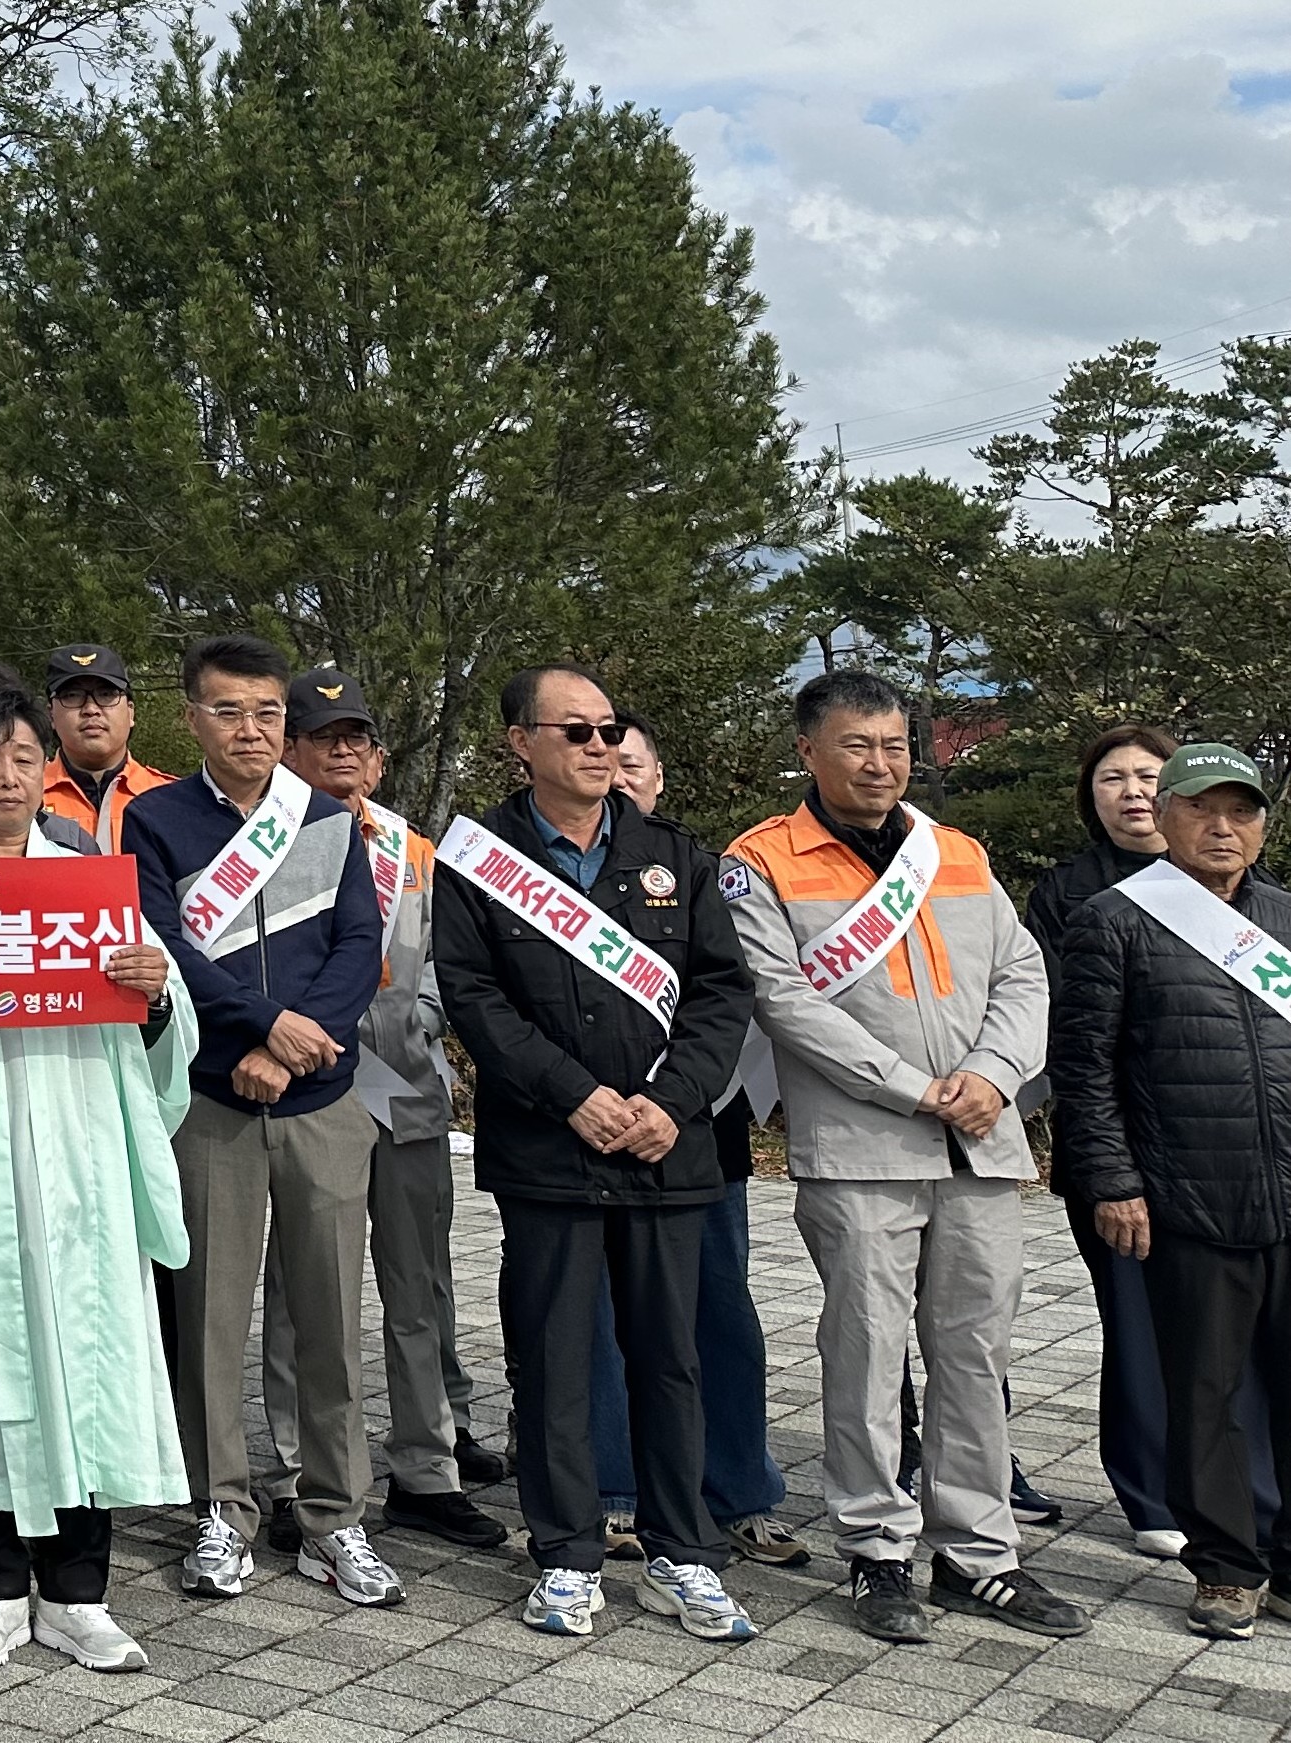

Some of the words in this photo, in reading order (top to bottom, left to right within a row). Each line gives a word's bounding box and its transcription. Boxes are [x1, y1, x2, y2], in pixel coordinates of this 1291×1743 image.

[1186, 755, 1220, 767] NEW
[1220, 756, 1255, 777] YORK
[182, 815, 289, 943] 산불조
[473, 846, 593, 942] 불조심
[23, 991, 83, 1014] 영천시
